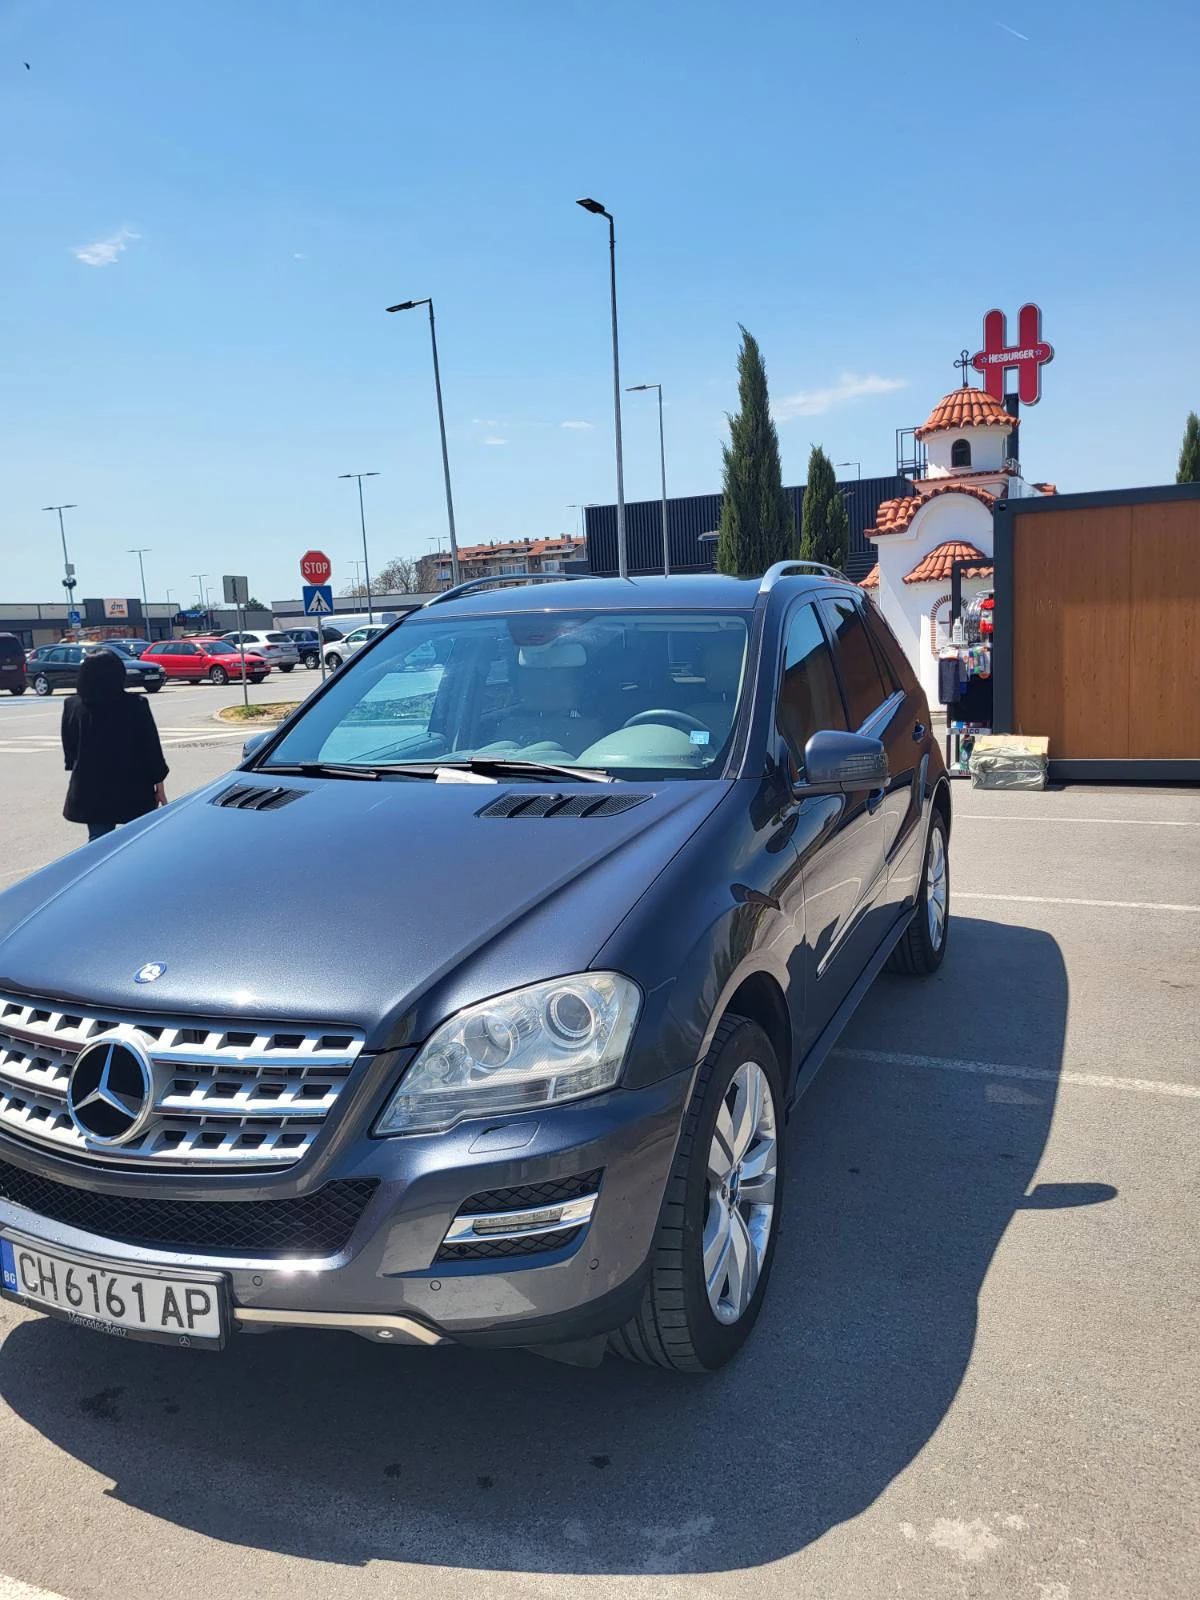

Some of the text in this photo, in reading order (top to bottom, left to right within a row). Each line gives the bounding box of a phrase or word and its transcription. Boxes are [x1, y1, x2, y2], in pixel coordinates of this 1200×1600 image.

[988, 349, 1035, 364] HESBURGER
[304, 561, 328, 574] STOP
[4, 1270, 16, 1284] BG
[65, 1267, 146, 1322] 6161
[161, 1286, 211, 1329] AP
